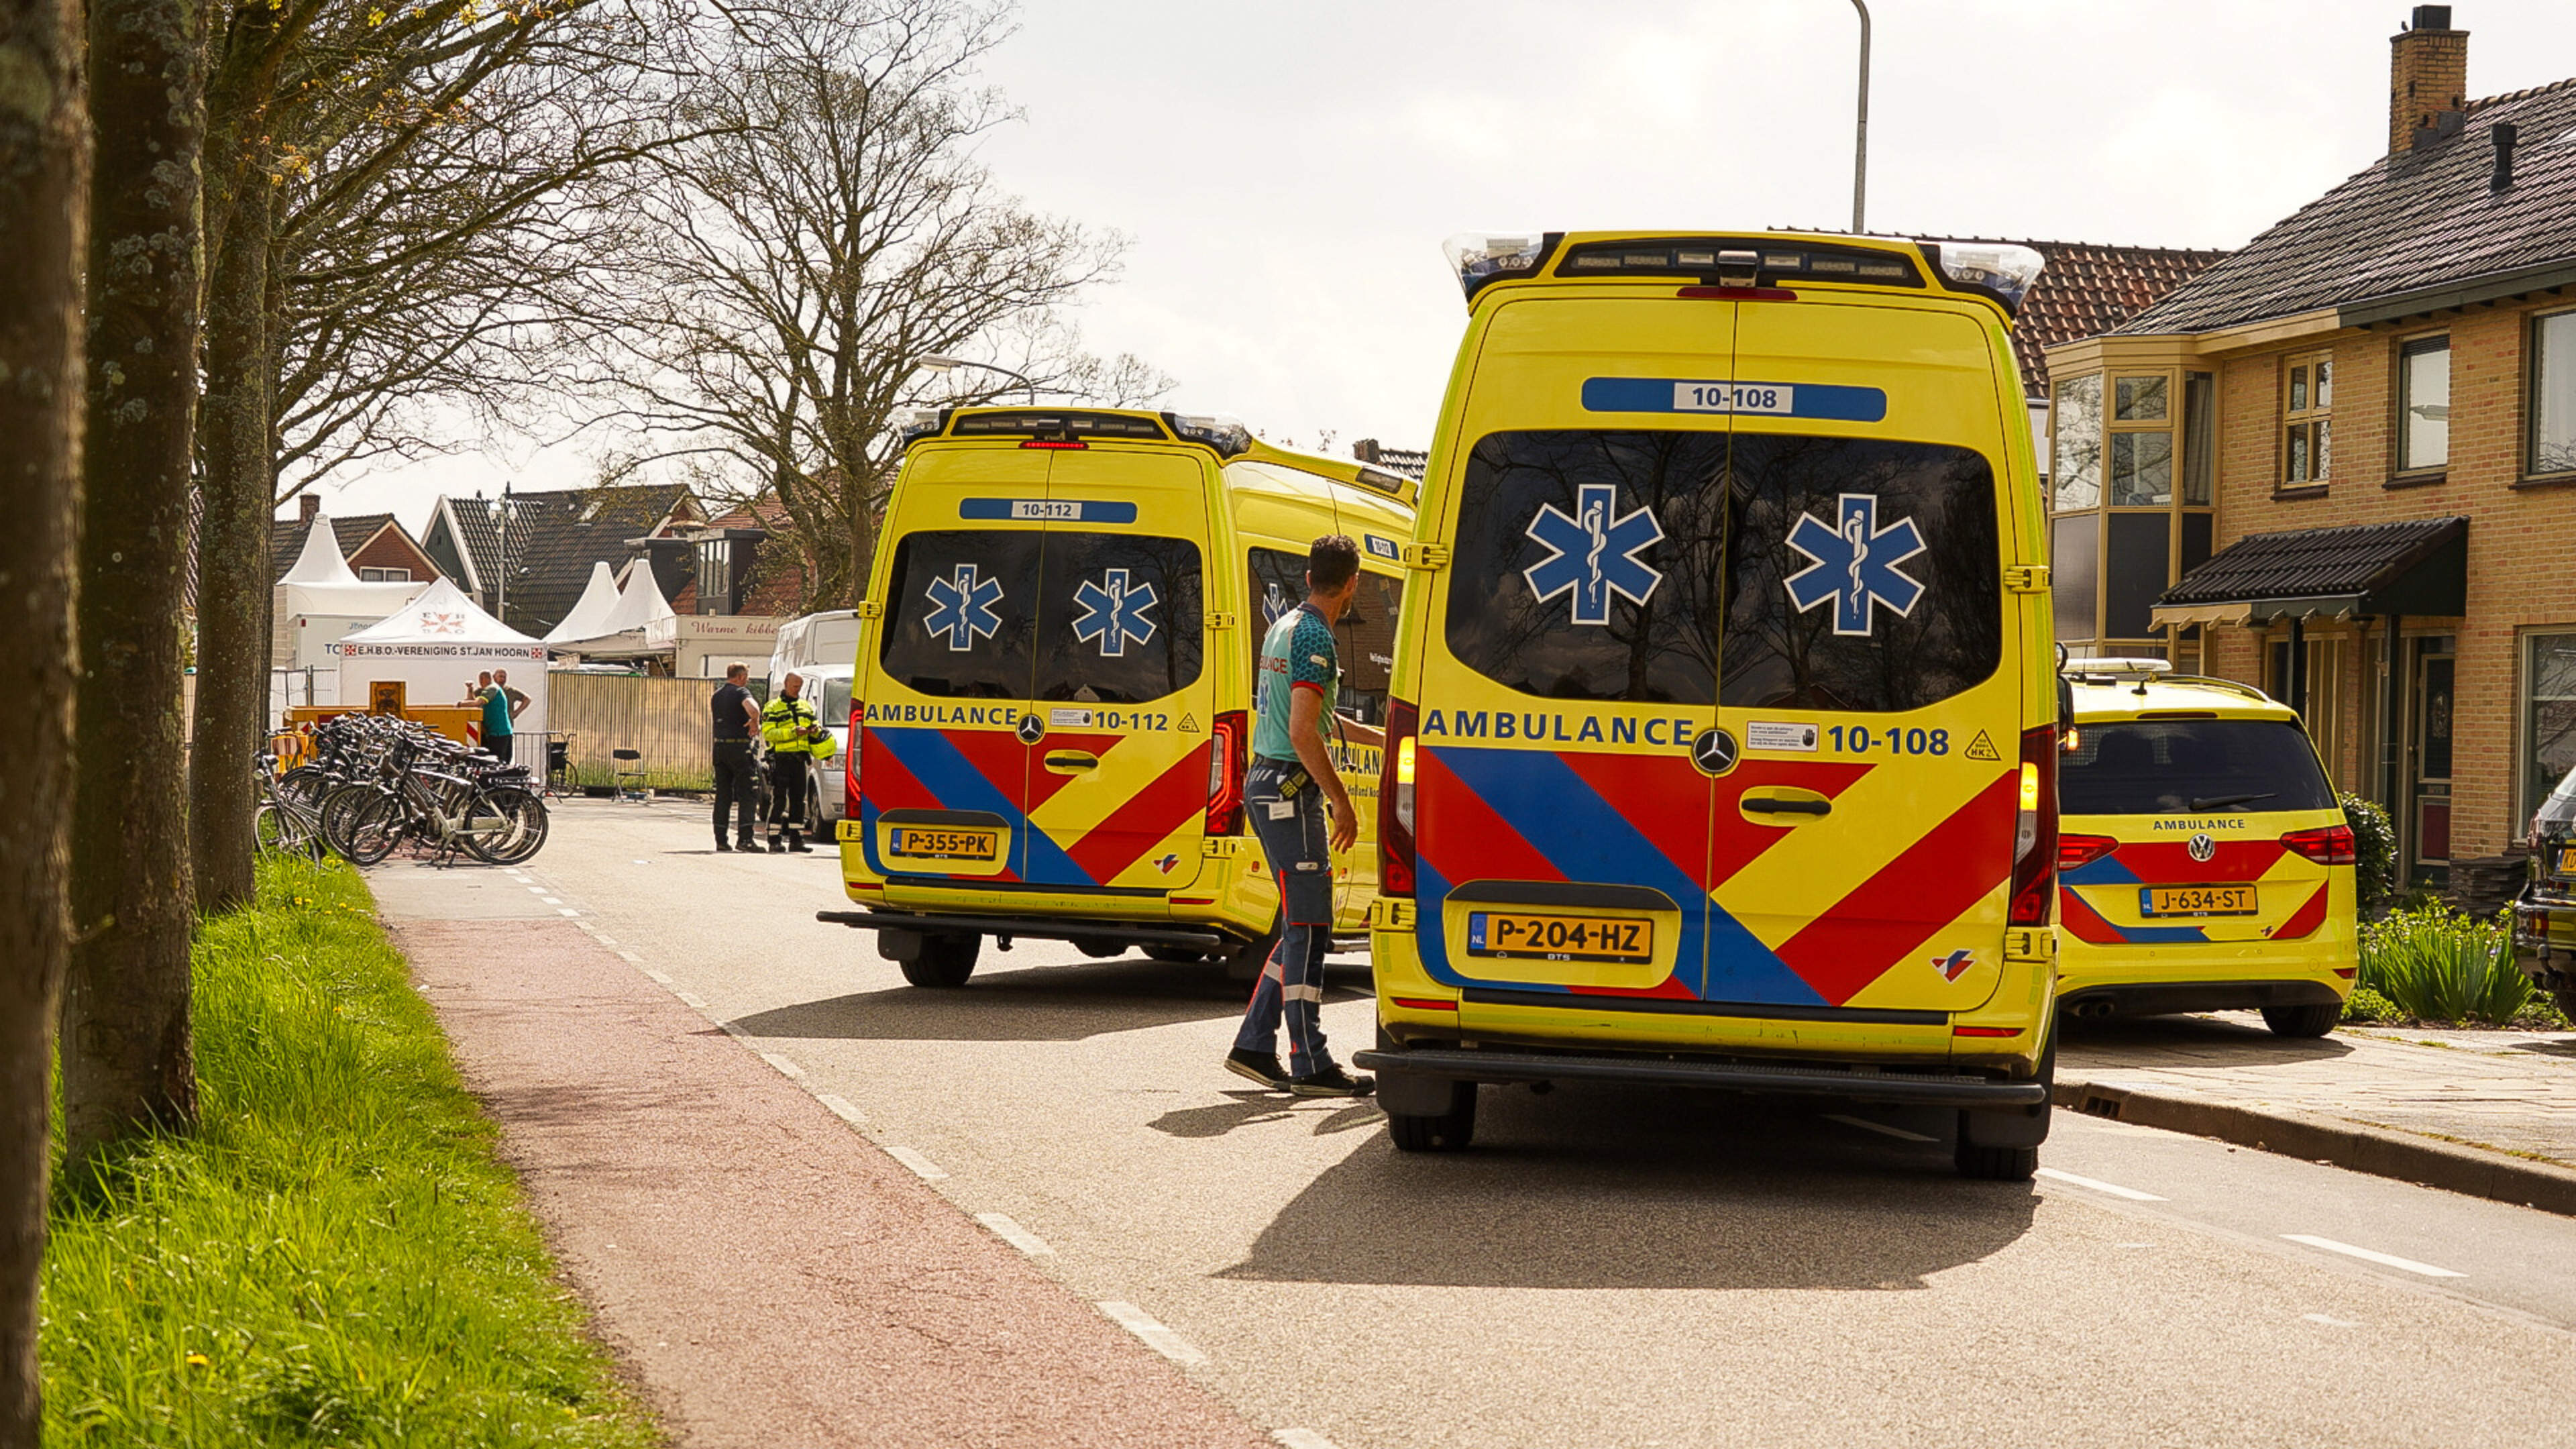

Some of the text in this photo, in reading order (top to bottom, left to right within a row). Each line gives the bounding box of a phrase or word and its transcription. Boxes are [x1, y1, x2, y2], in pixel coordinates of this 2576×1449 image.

[1693, 387, 1777, 408] 10-108
[1022, 504, 1072, 517] 10-112
[691, 621, 779, 635] Warme kibbe
[494, 647, 530, 657] HOORN
[865, 704, 1018, 725] AMBULANCE
[1095, 711, 1168, 731] 10-112
[1421, 709, 1694, 746] AMBULANCE
[1827, 725, 1949, 755] 10-108
[2153, 819, 2245, 830] AMBULANCE
[908, 833, 988, 853] P-355-PK
[2161, 890, 2246, 910] J-634-ST
[1472, 935, 1485, 944] NL
[1497, 918, 1641, 951] P-204-HZ
[1548, 953, 1570, 961] BTS
